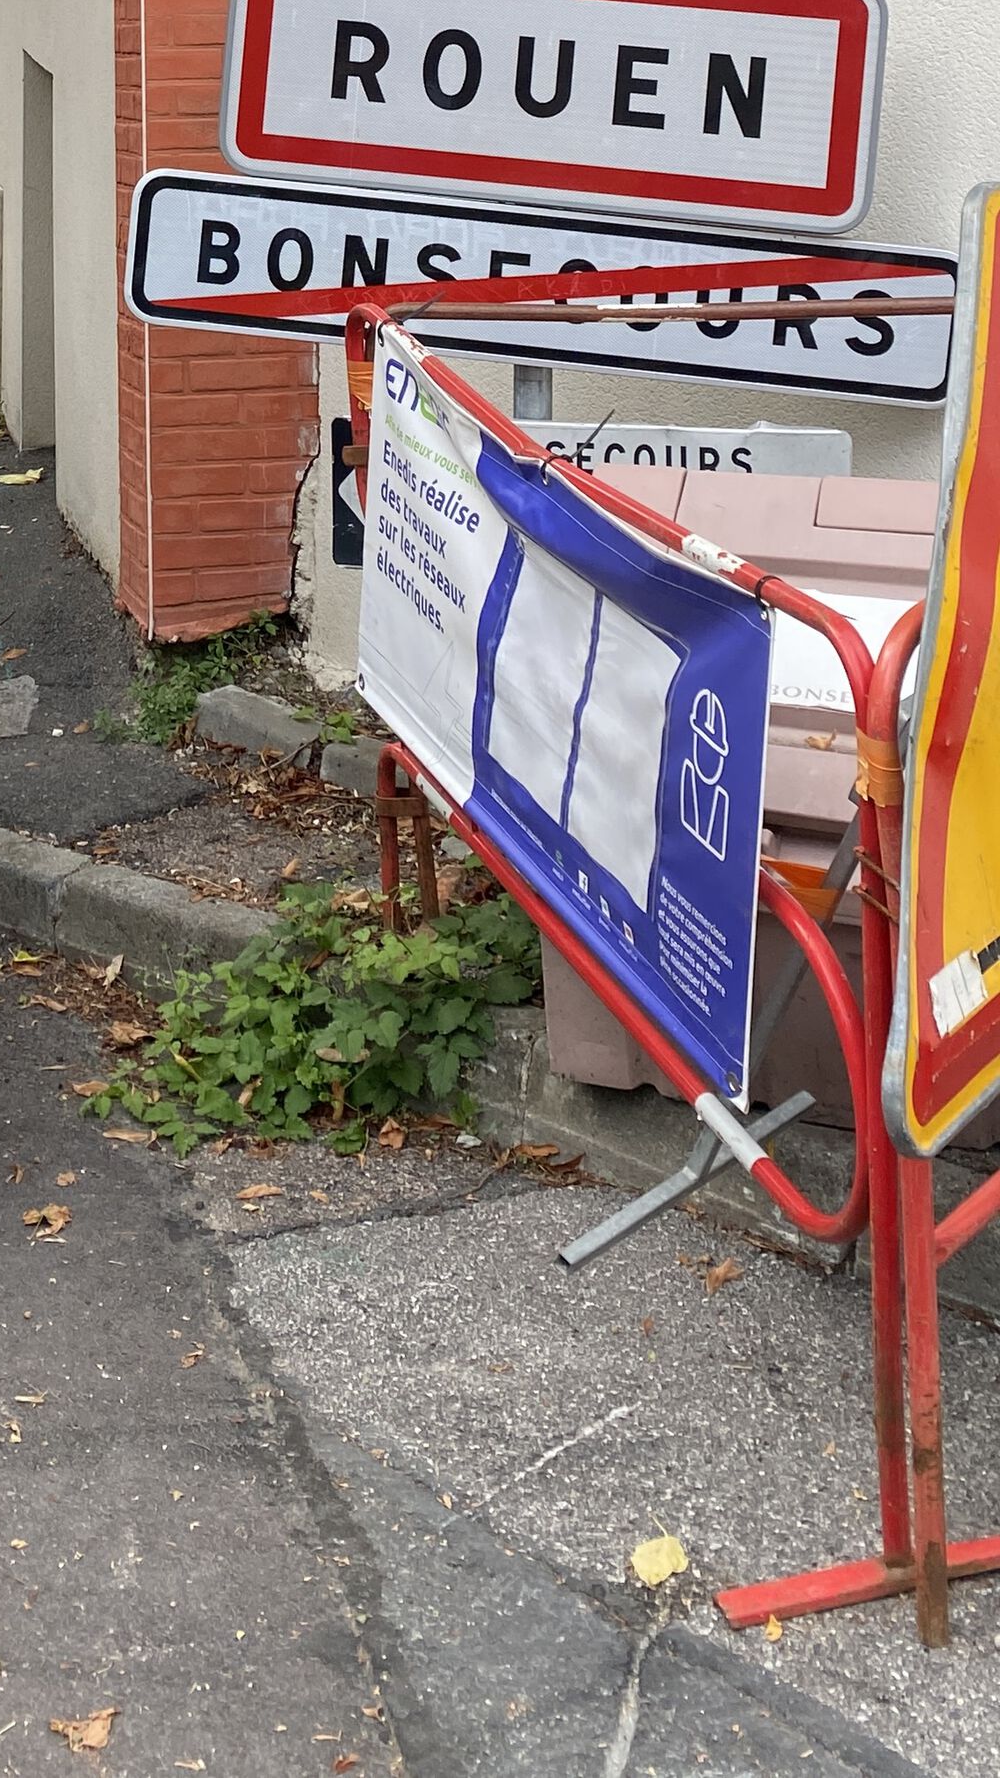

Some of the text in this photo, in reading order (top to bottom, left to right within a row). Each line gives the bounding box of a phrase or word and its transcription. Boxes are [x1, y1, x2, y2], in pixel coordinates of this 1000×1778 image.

[331, 19, 767, 139] ROUEN
[383, 439, 480, 534] Enedis réalise
[404, 432, 433, 461] mieux
[434, 453, 459, 476] vous
[380, 477, 447, 559] des travaux
[376, 546, 445, 633] électriques.
[378, 514, 466, 614] sur les réseaux
